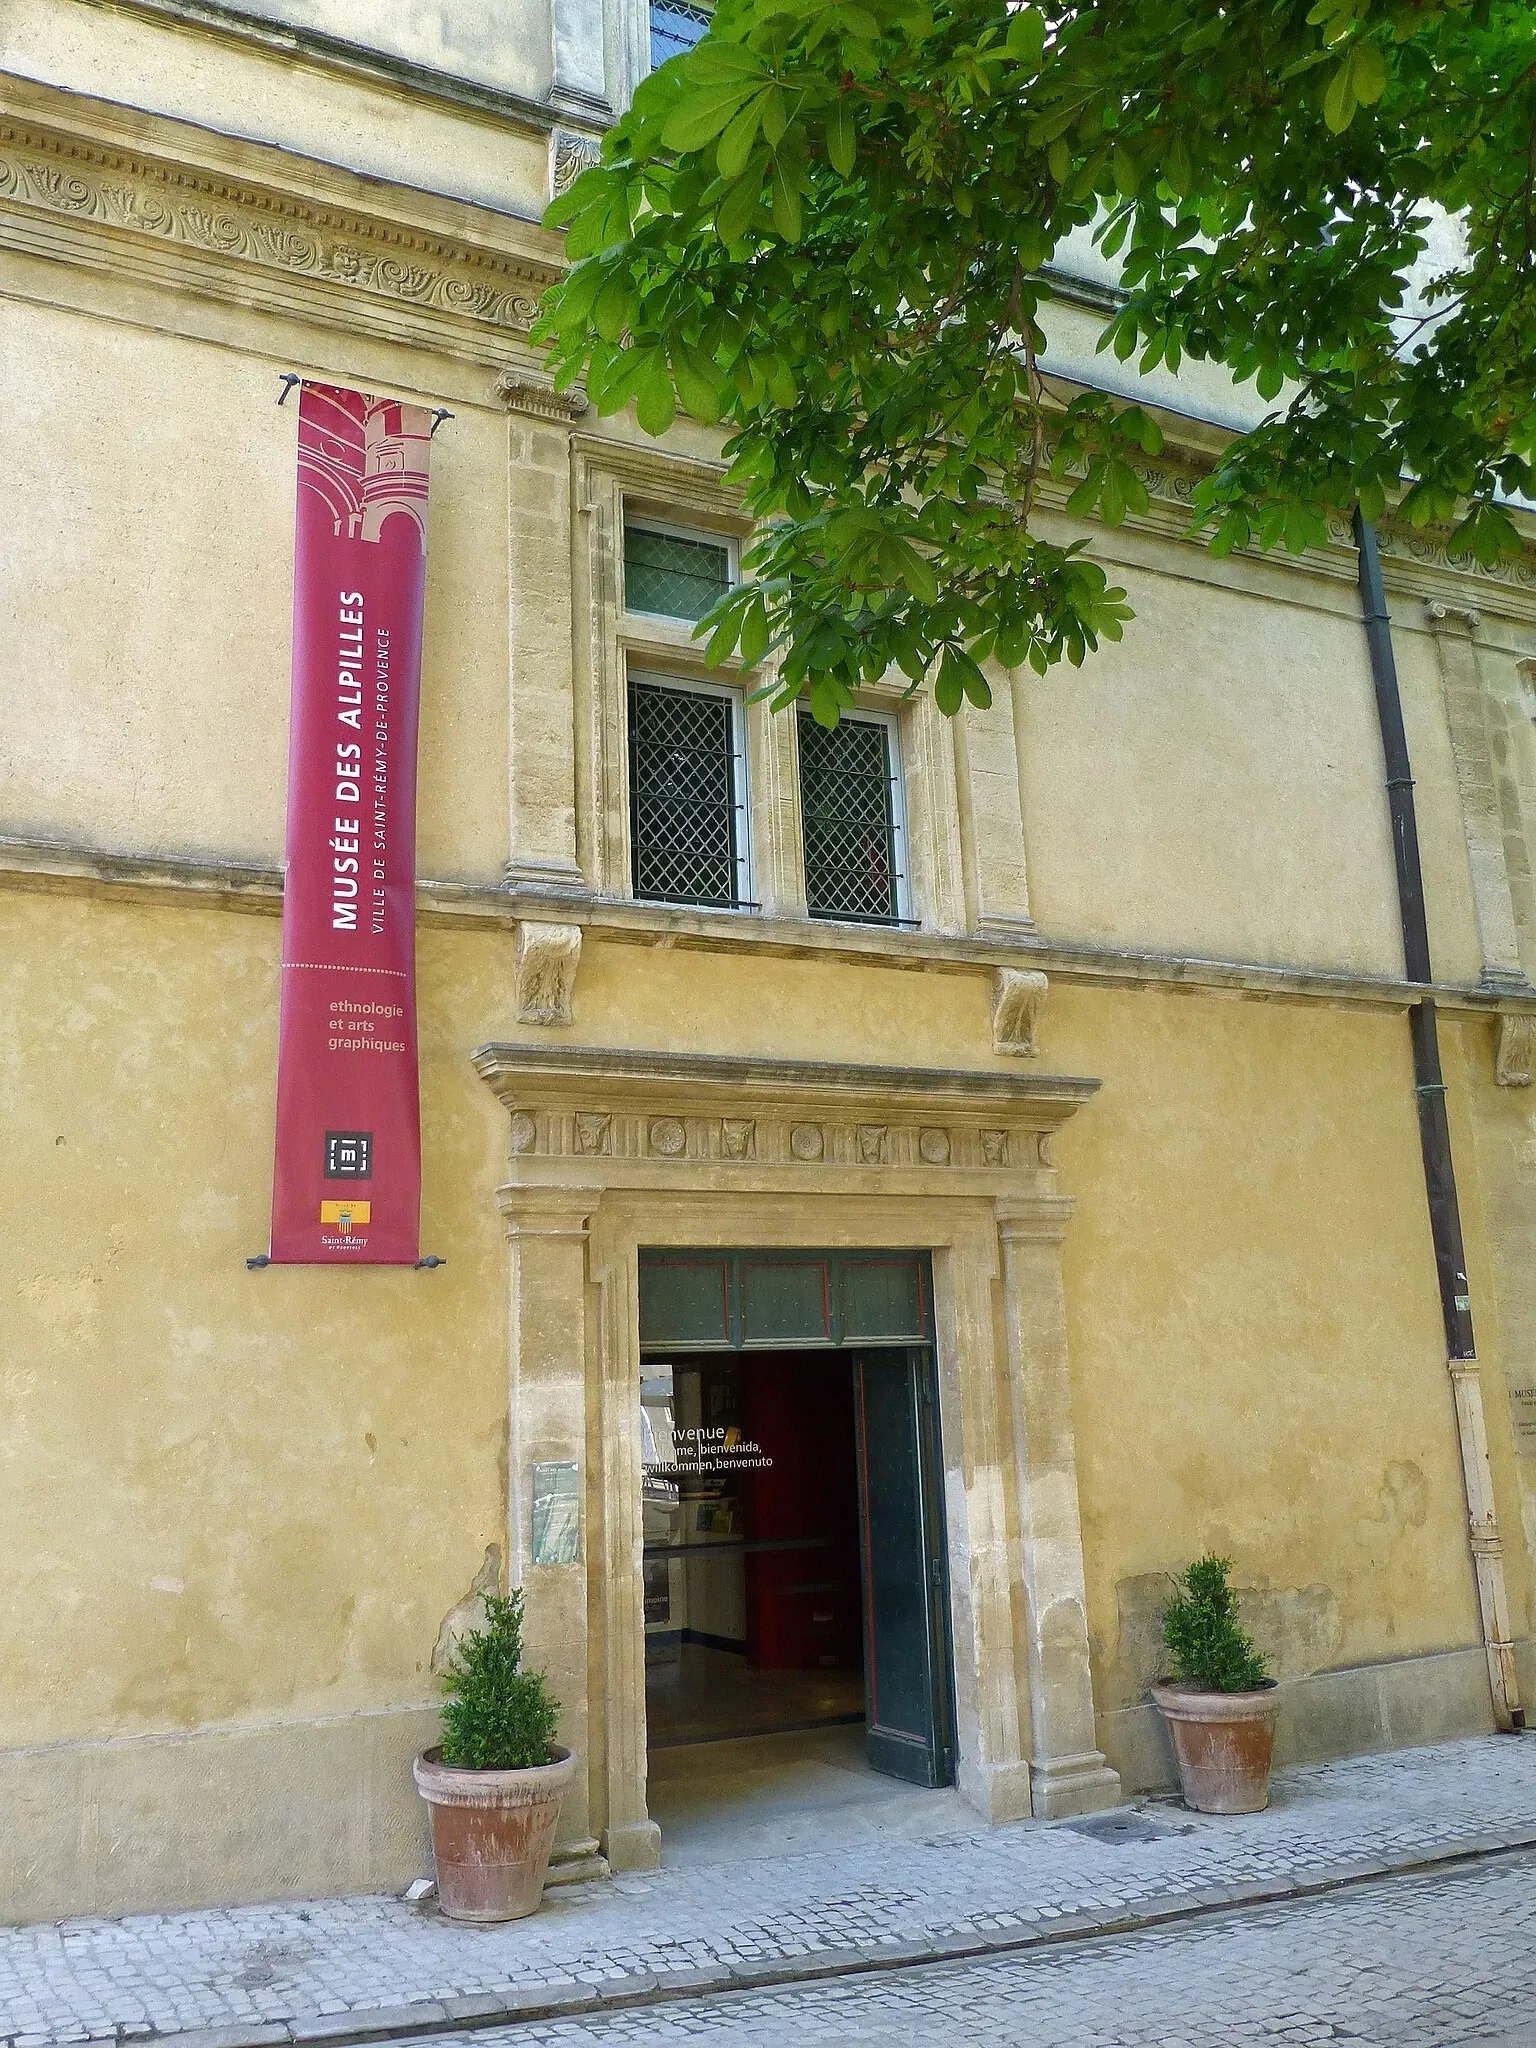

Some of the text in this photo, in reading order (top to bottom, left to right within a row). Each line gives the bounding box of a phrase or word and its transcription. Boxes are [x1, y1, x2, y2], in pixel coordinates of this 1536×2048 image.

[329, 591, 365, 930] MUSÉE DES ALPILLES
[372, 628, 390, 934] VILLE DE SAINT-RÉMY-DE-PROVENCE
[329, 1000, 404, 1018] ethnologie
[329, 1019, 375, 1032] et arts
[328, 1037, 406, 1053] graphiques
[321, 1235, 368, 1248] Saint-Rémy
[701, 1441, 762, 1455] bienvenida,
